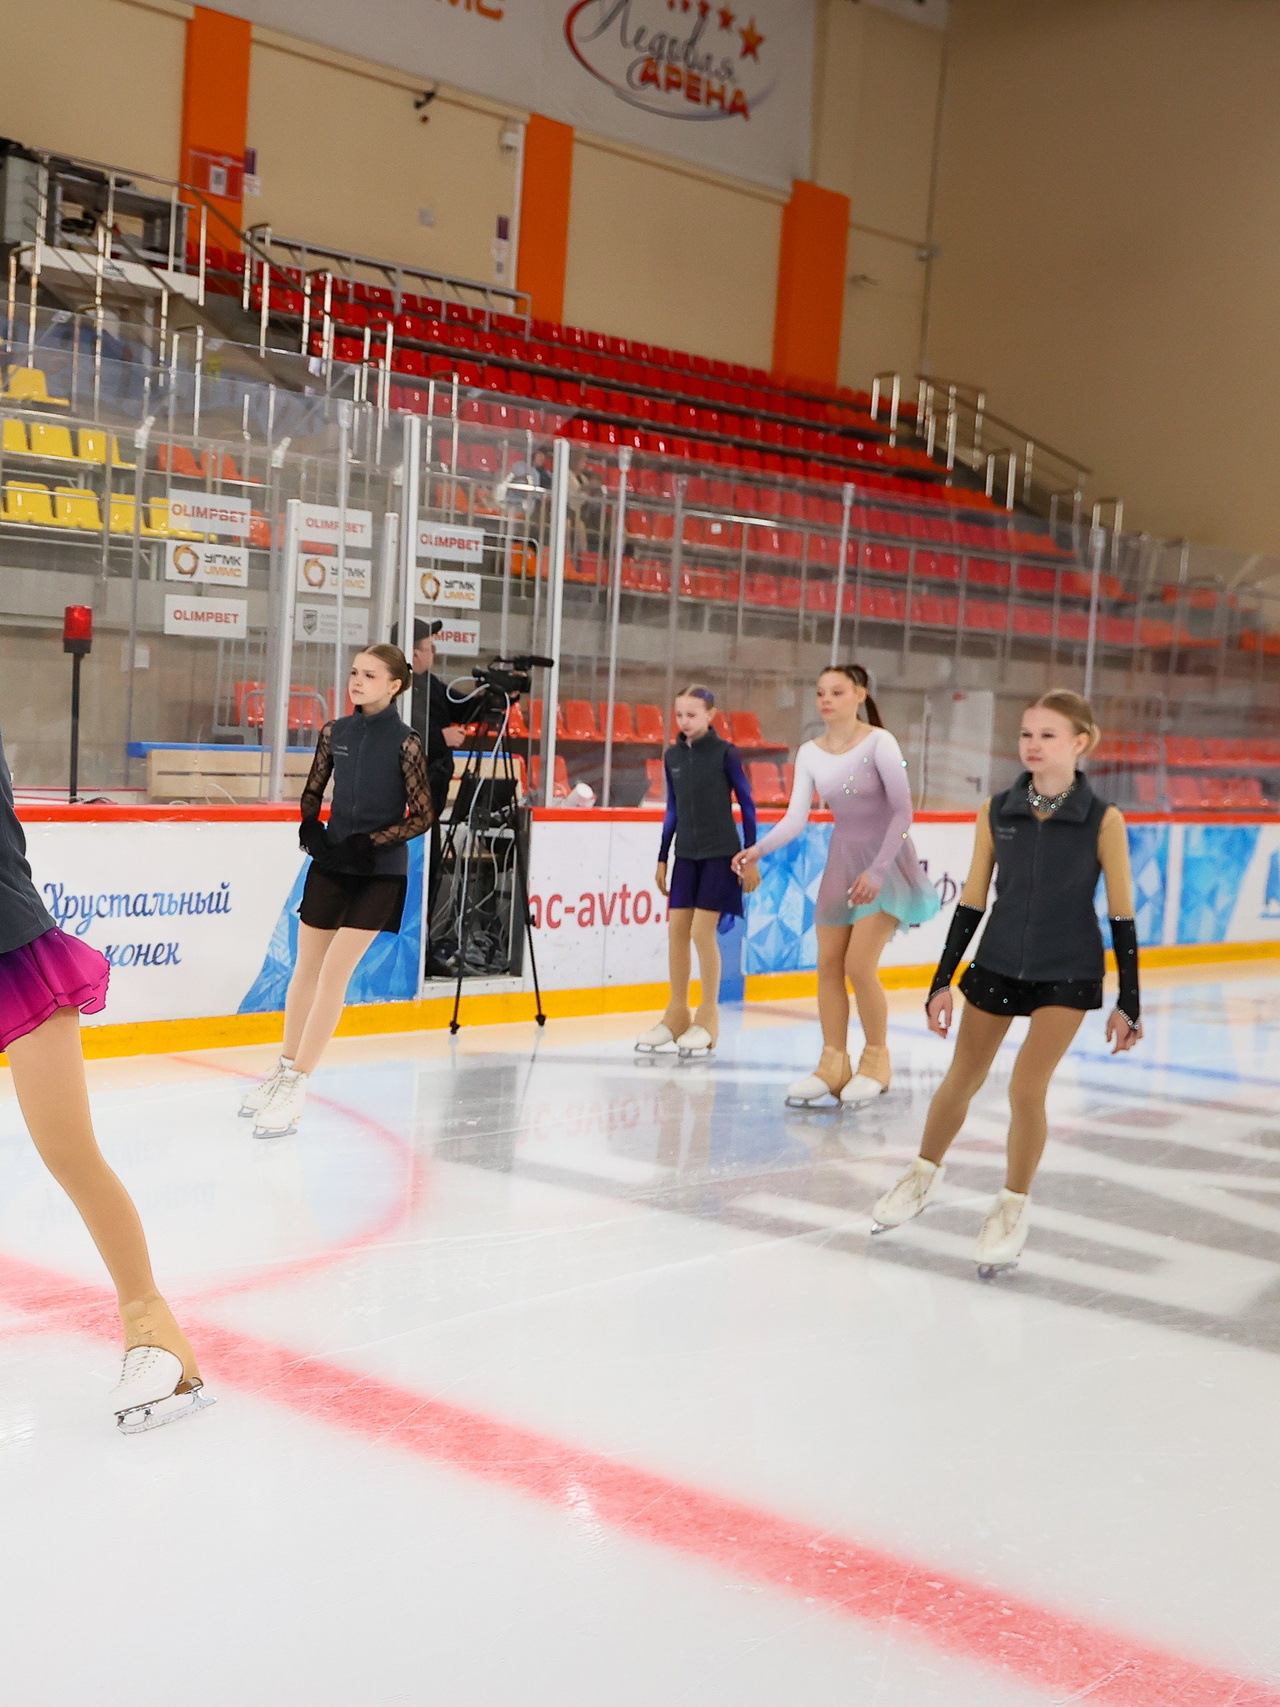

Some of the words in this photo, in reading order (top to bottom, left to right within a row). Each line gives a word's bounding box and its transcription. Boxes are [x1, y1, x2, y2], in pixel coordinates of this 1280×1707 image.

[640, 57, 750, 121] АРЕНА
[171, 503, 247, 524] OLIMPBET
[420, 533, 480, 552] OLIMPBET
[173, 609, 239, 624] OLIMPBET
[43, 881, 231, 936] Хрустальный
[104, 942, 182, 967] конек
